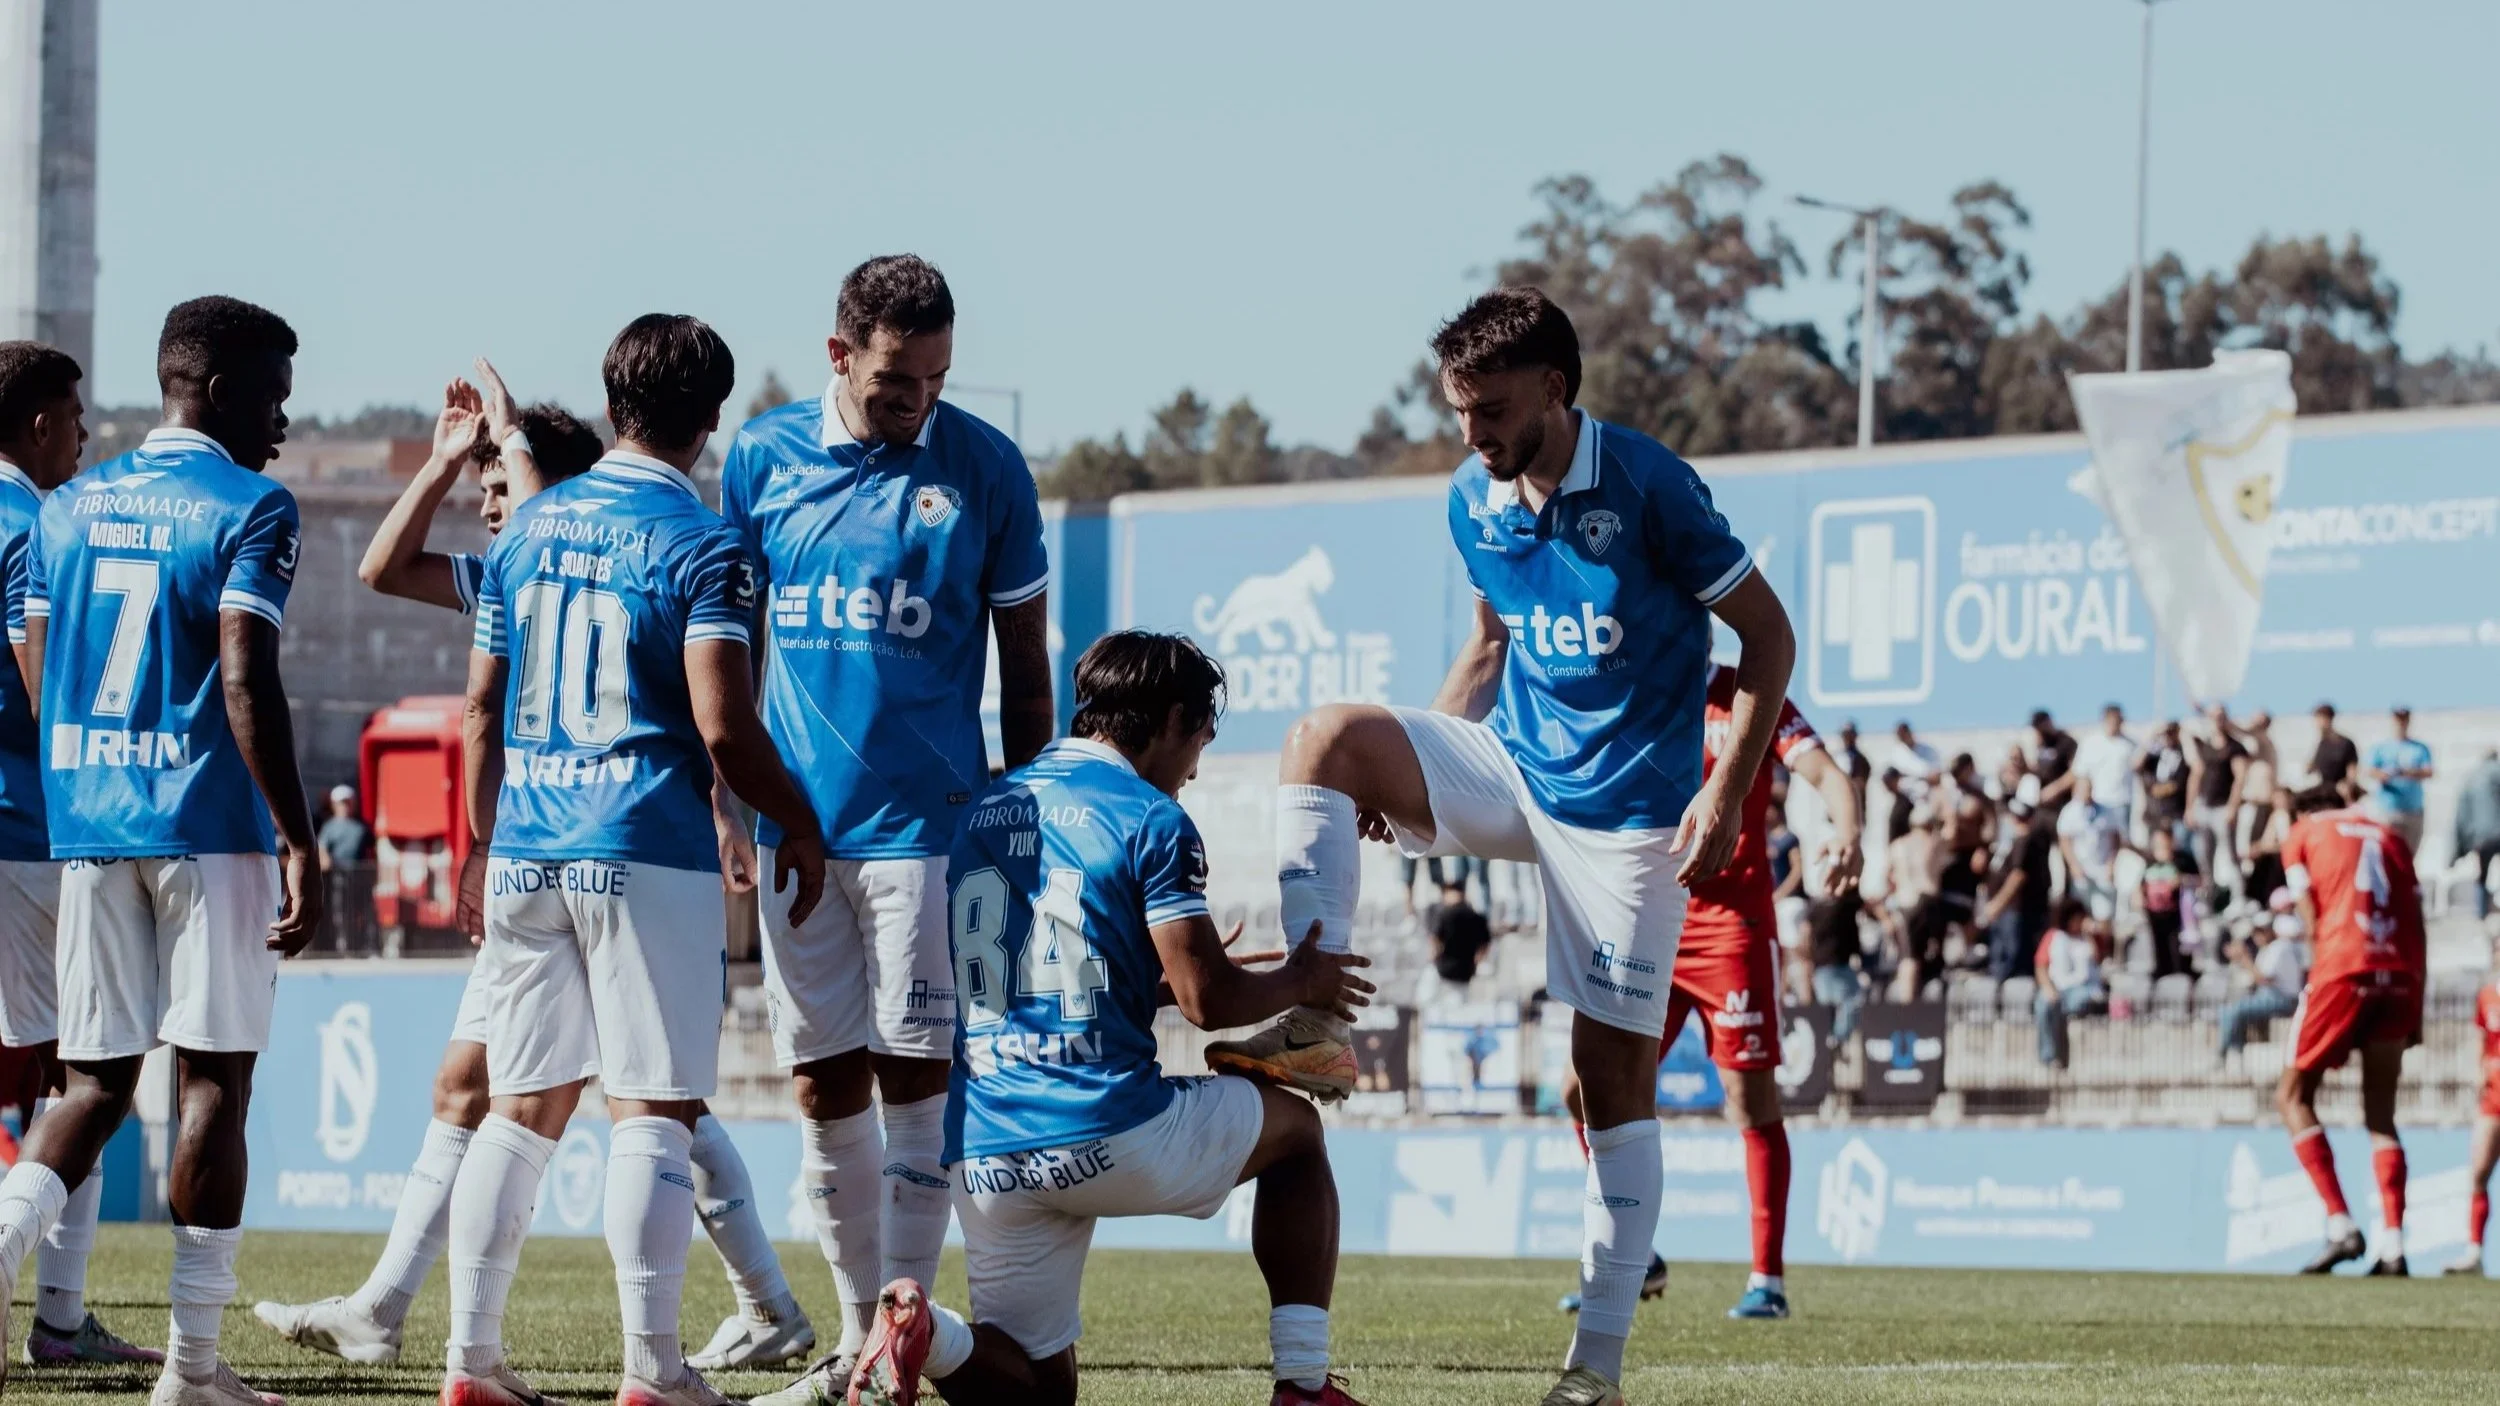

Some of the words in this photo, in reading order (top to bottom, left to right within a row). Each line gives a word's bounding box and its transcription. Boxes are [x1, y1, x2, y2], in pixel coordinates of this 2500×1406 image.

[73, 492, 207, 522] FIBROMADE
[2276, 496, 2498, 549] ONTACONCEPT
[88, 521, 147, 551] MIGUEL
[150, 526, 172, 552] M.
[276, 535, 300, 570] 3
[526, 518, 656, 556] FIBROMADE
[537, 547, 555, 574] A.
[559, 550, 614, 583] SOARES
[736, 562, 754, 597] 3
[817, 574, 932, 639] teb
[1943, 576, 2146, 664] OURAL
[91, 557, 160, 718] 7
[816, 636, 830, 650] de
[1530, 602, 1624, 657] teb
[515, 580, 631, 747] 10
[1228, 653, 1300, 712] DER
[85, 729, 190, 770] RHN
[529, 749, 637, 788] RHN
[968, 804, 1093, 832] FIBROMADE
[1007, 831, 1038, 858] YUK
[593, 859, 627, 870] Empire
[952, 866, 1109, 1031] 84
[1613, 958, 1656, 975] PAREDES
[1586, 973, 1654, 1001] MARTINSPORT
[997, 1031, 1103, 1067] RHN
[1069, 1139, 1103, 1158] Empire
[961, 1167, 1050, 1195] UNDER
